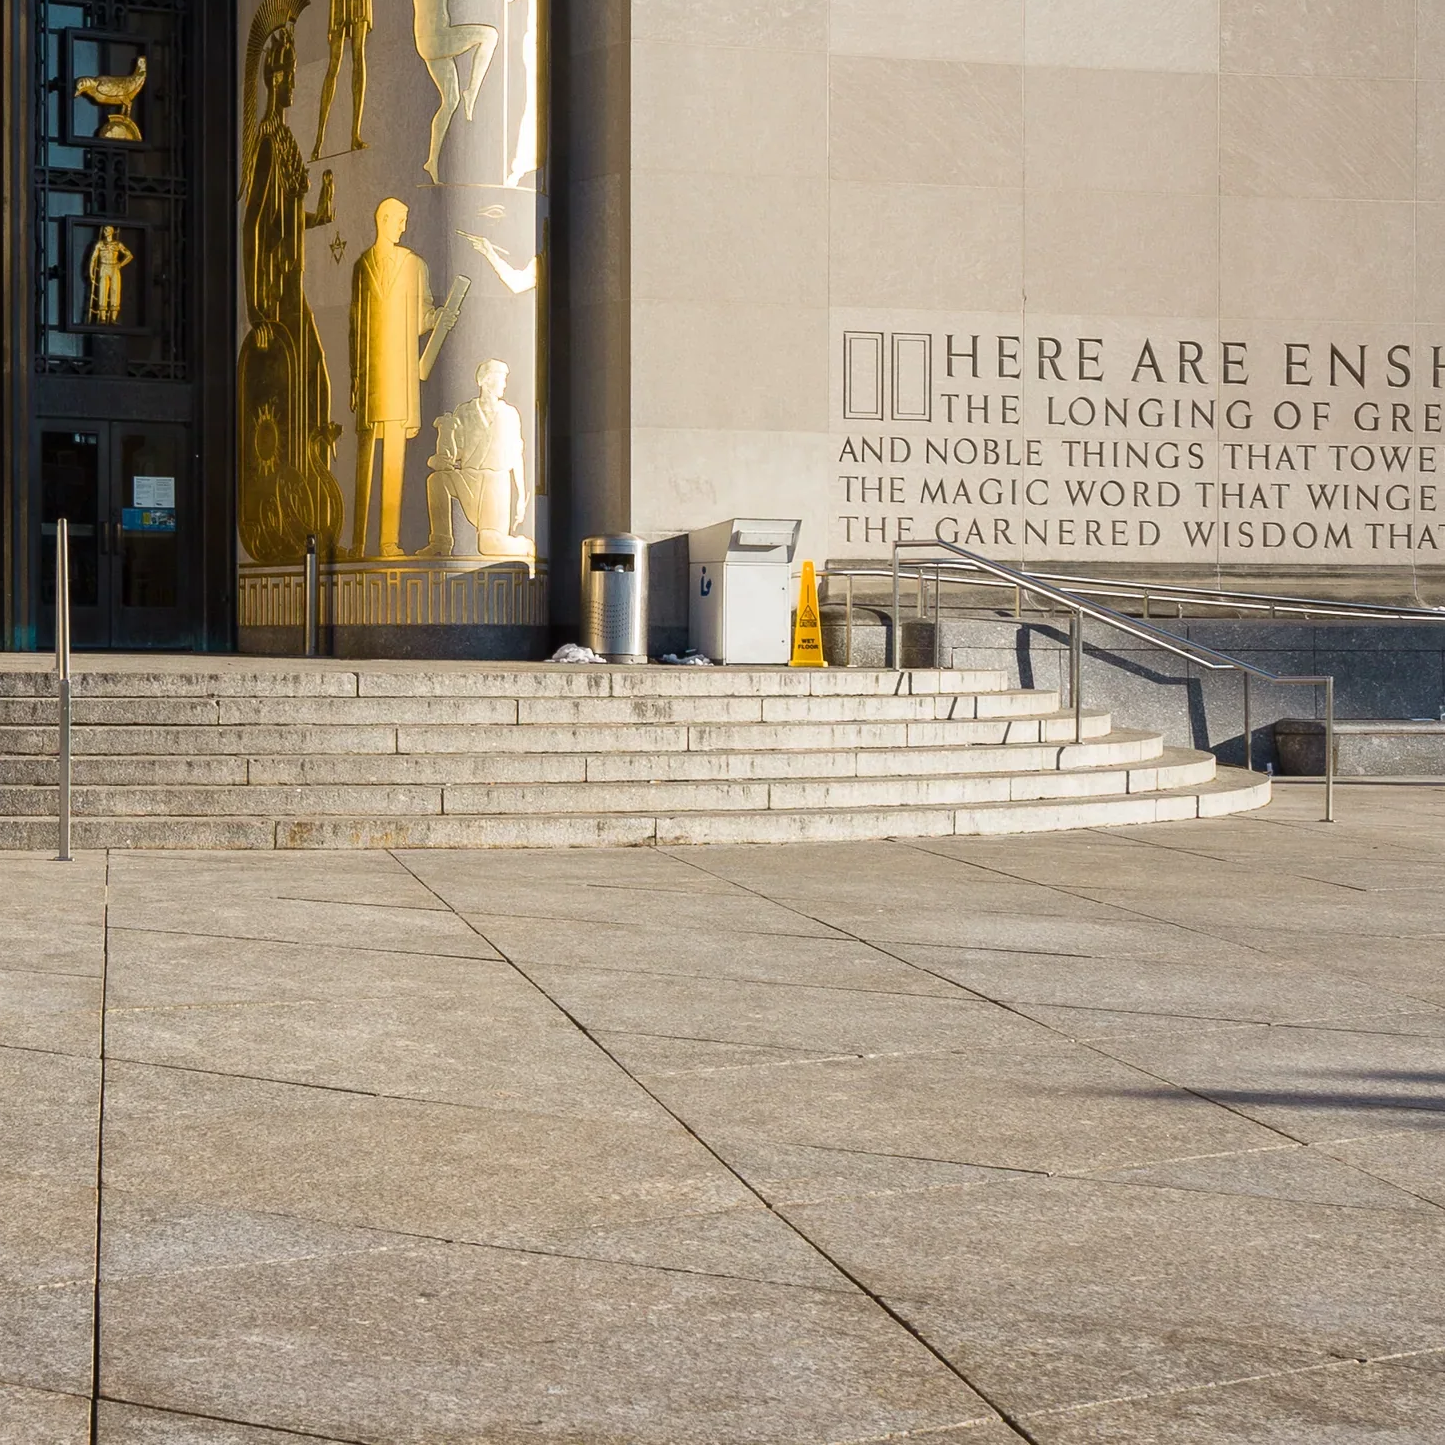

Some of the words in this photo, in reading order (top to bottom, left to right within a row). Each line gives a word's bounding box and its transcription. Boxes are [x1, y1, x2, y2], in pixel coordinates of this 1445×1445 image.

[945, 334, 1104, 382] HERE
[1131, 338, 1249, 385] ARE
[941, 394, 1020, 425] THE
[1048, 397, 1253, 429] LONGING
[1274, 401, 1330, 430] OF
[1354, 402, 1442, 433] GRE
[839, 436, 911, 464] AND
[926, 438, 1043, 466] NOBLE
[1062, 441, 1204, 469] THINGS
[1224, 444, 1317, 471] THAT
[1329, 446, 1436, 473] TOWE
[839, 476, 905, 503] THE
[920, 478, 1049, 505] MAGIC
[1064, 480, 1180, 507] WORD
[1195, 482, 1290, 510] THAT
[1306, 484, 1436, 511] WINGE
[839, 516, 915, 545] THE
[935, 517, 1160, 548] GARNERED
[1183, 521, 1353, 549] WISDOM
